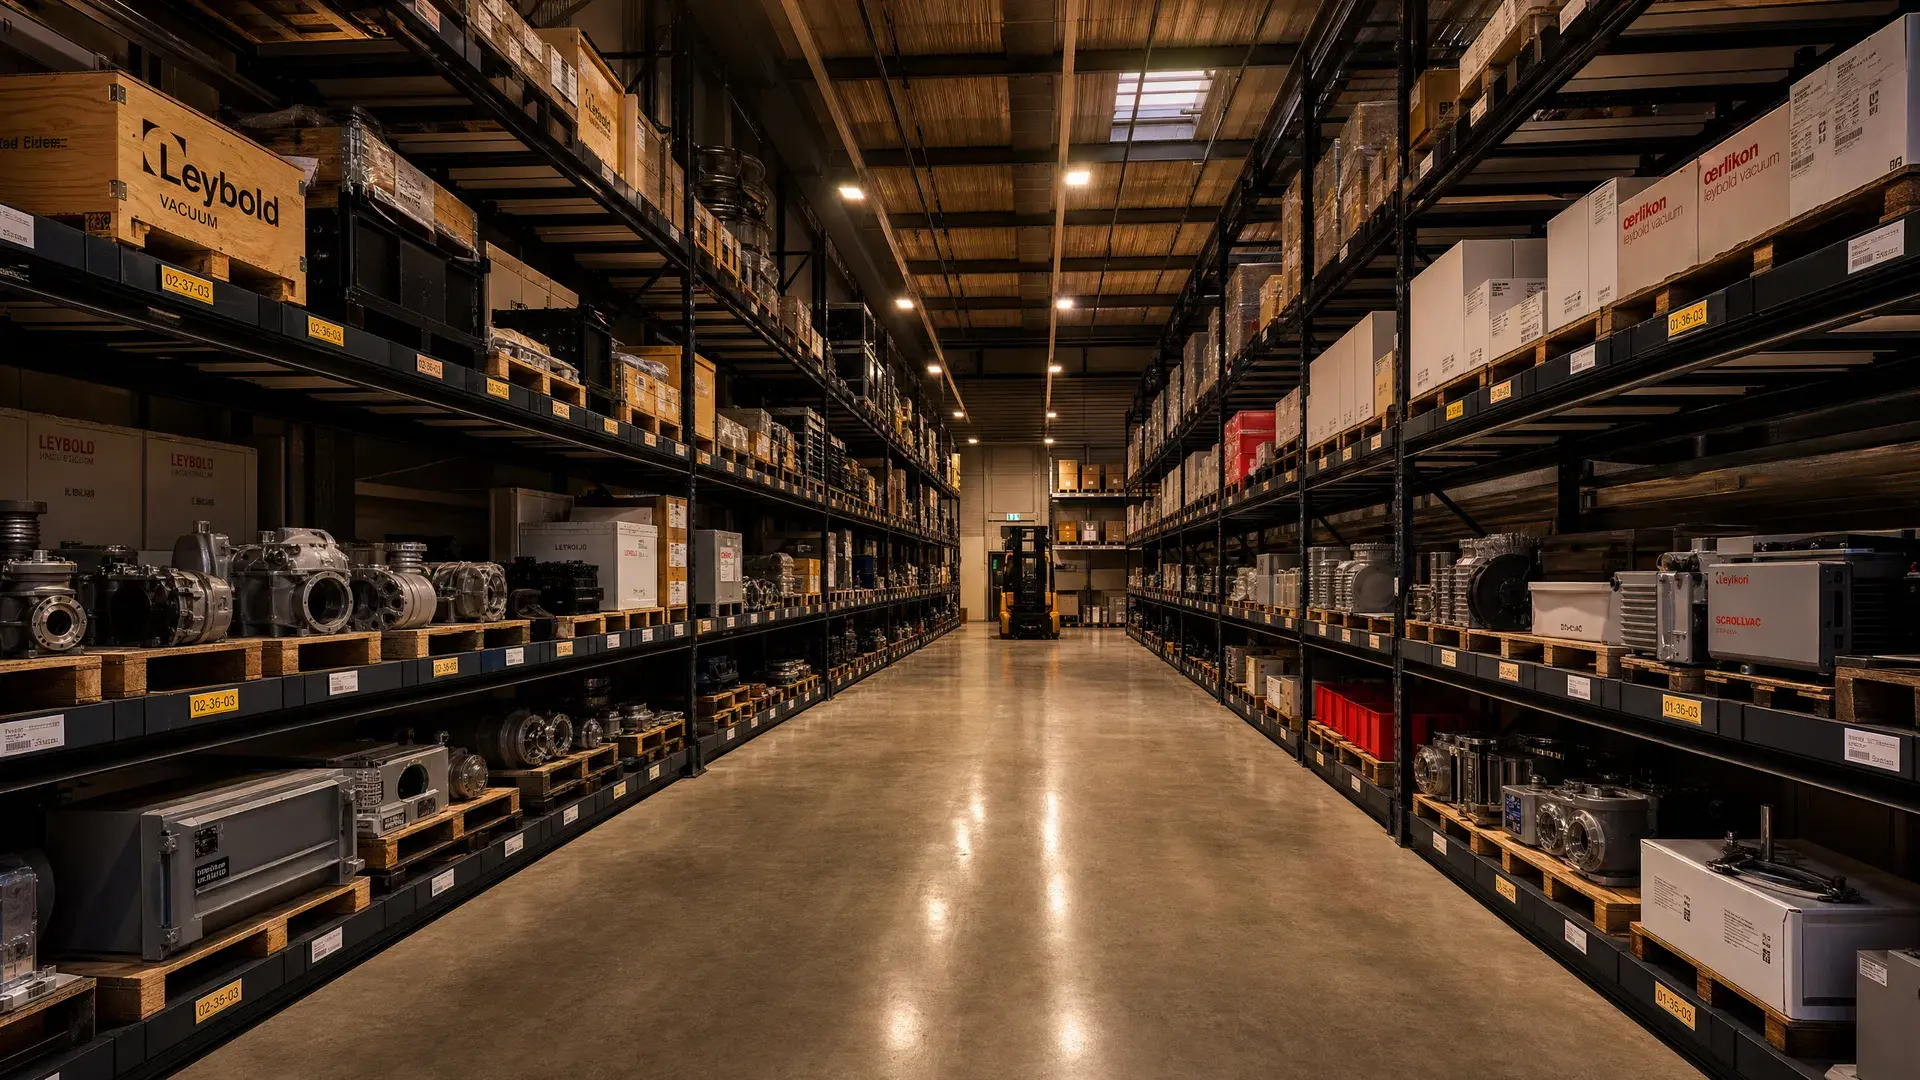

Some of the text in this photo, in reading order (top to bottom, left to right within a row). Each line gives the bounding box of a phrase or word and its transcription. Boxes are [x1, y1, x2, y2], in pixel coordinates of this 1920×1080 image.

[160, 142, 279, 227] Leybold
[1703, 152, 1780, 203] leybold vacuum
[159, 193, 218, 230] VACUUM
[1623, 204, 1684, 246] leybold vacuum
[165, 273, 211, 299] 02-37-03
[1670, 307, 1704, 331] 01-36-03
[310, 322, 342, 342] 02-36-03
[38, 434, 95, 455] LEYBOLD
[171, 453, 214, 470] LEYBOLD
[1715, 615, 1762, 627] SCROLLVAC
[193, 695, 235, 713] 02-36-03
[1664, 700, 1699, 719] 01-36-03
[198, 986, 240, 1018] 02-35-03
[1657, 989, 1693, 1023] 01-35-03
